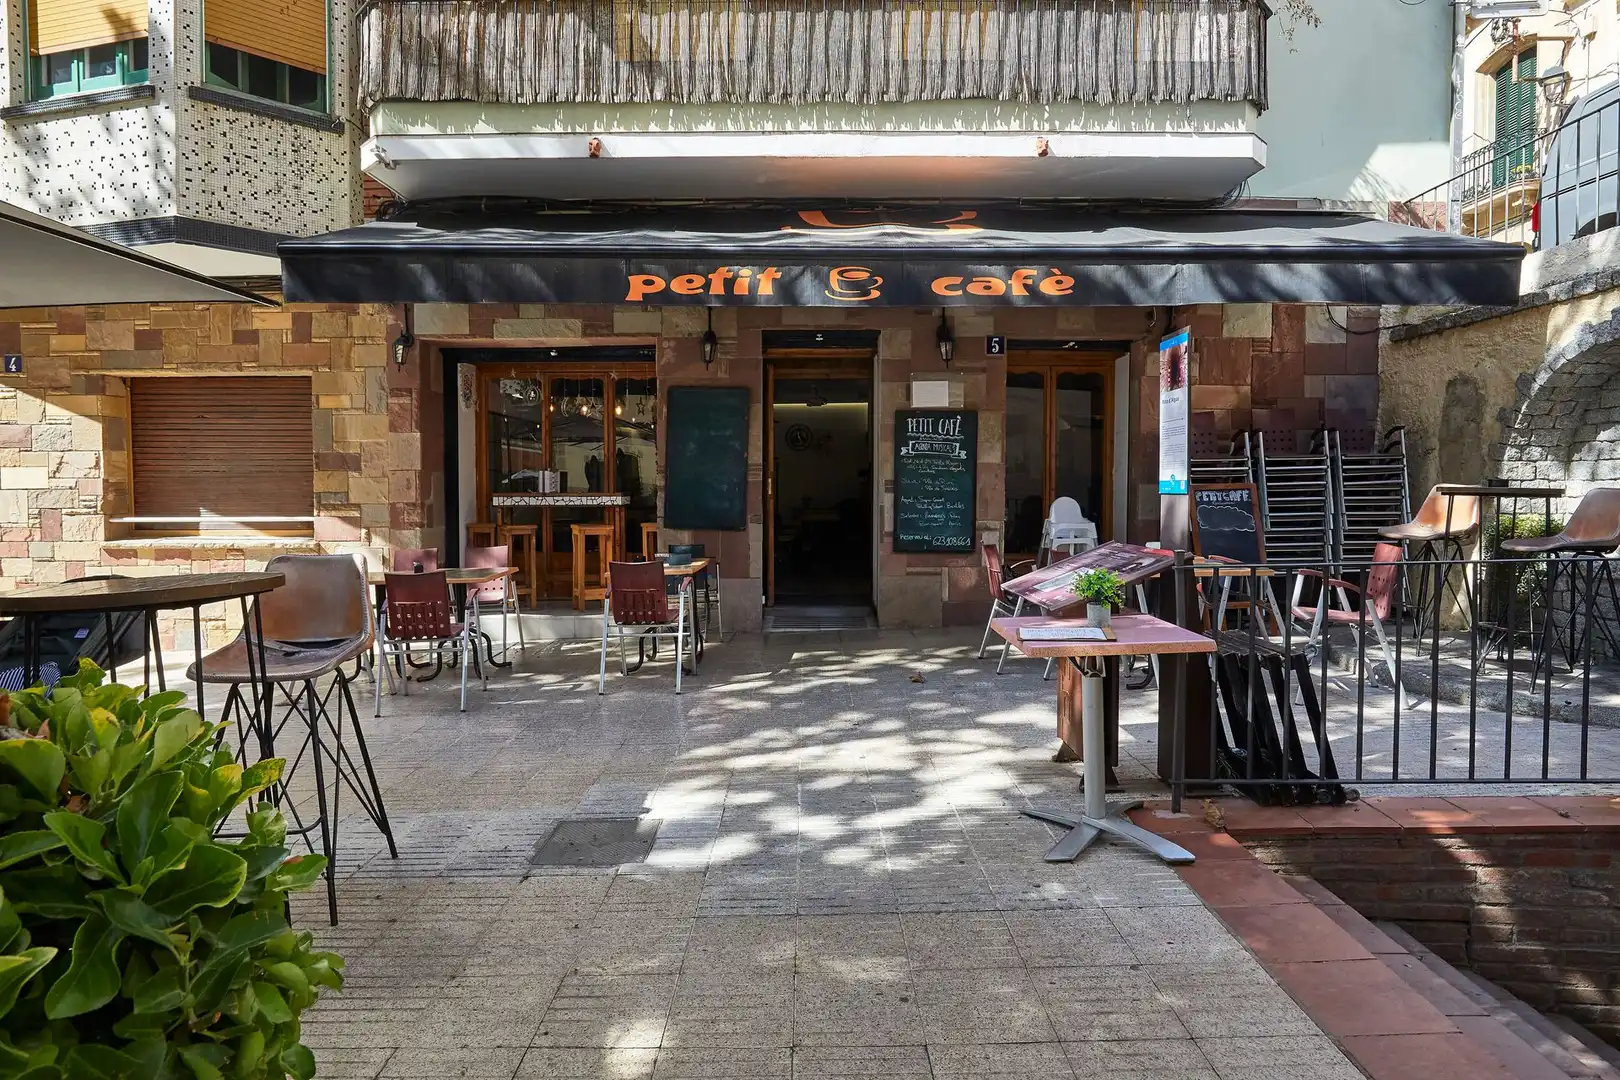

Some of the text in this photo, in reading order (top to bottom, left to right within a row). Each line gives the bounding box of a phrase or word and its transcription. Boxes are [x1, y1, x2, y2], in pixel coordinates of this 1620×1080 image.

[625, 266, 1075, 301] petit cafè
[991, 338, 1000, 353] 5
[9, 357, 17, 371] 4
[907, 417, 934, 433] PETIT
